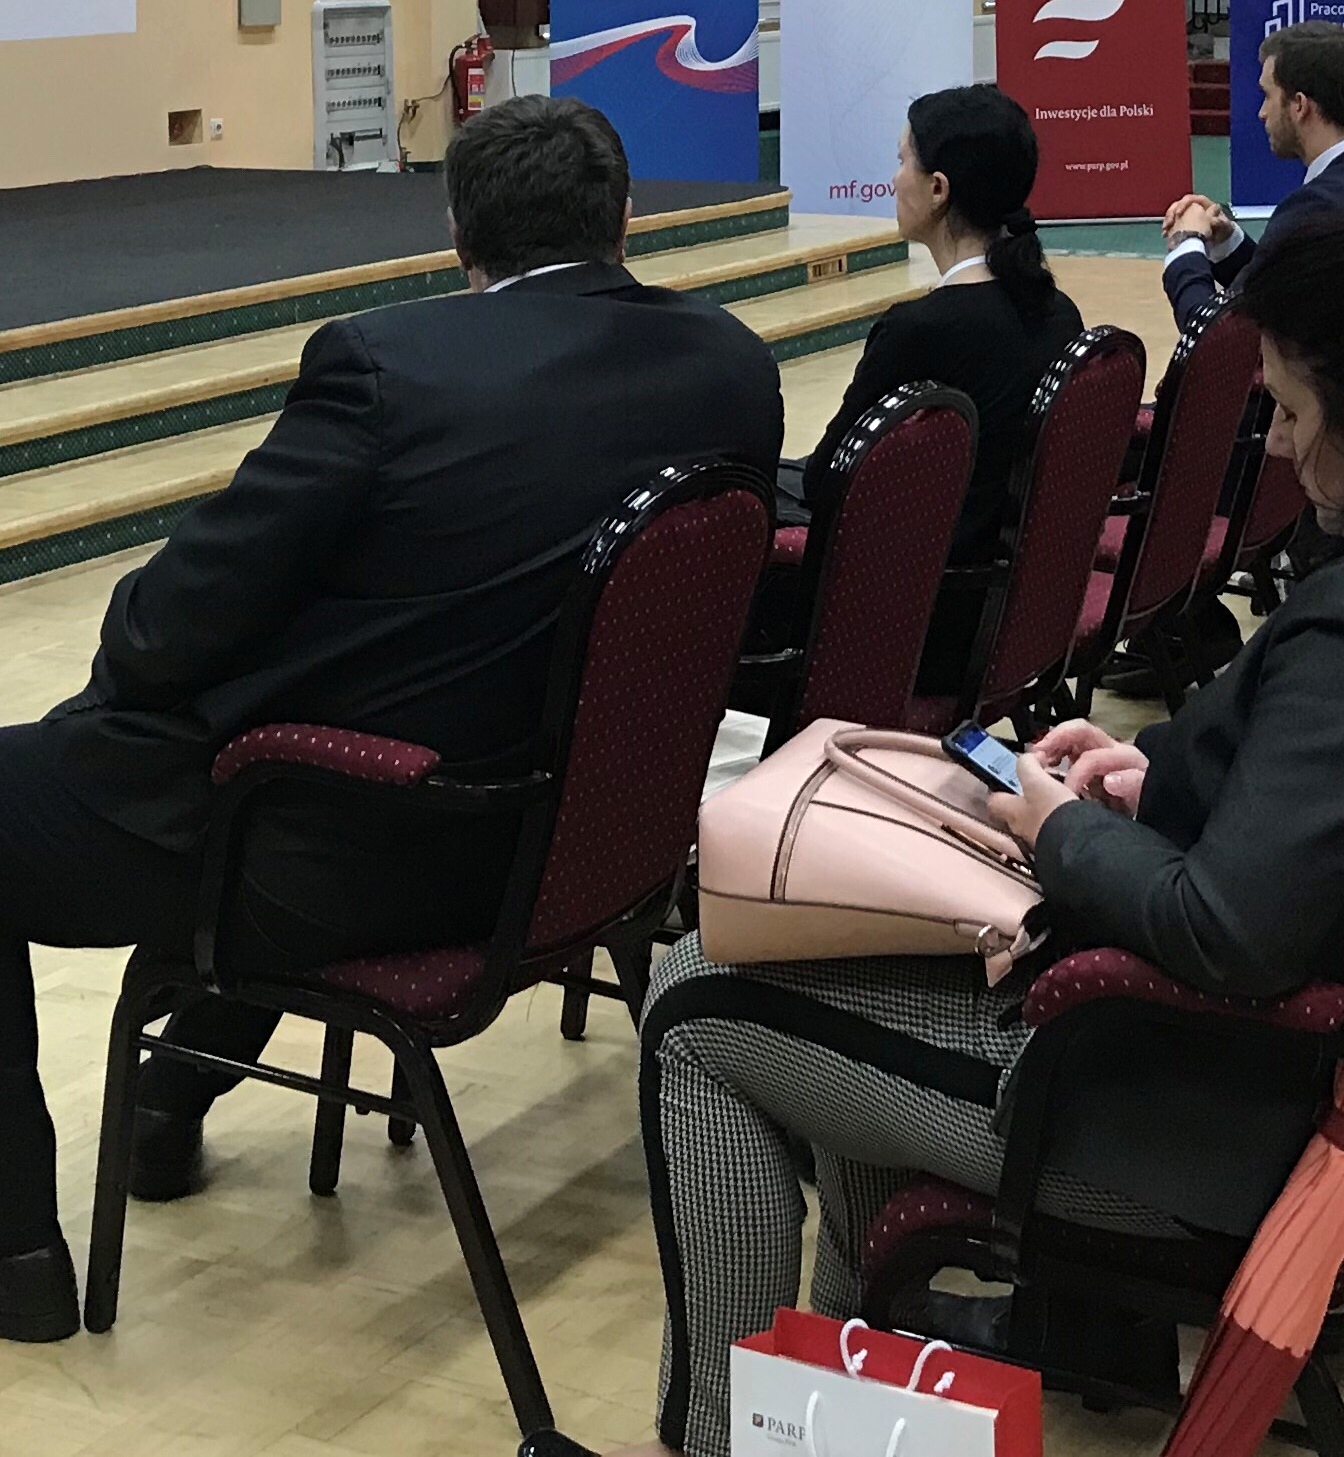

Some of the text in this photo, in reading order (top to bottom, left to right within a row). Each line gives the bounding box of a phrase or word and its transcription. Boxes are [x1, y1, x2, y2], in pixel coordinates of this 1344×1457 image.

[1035, 103, 1154, 122] Inwestycje dla Polski
